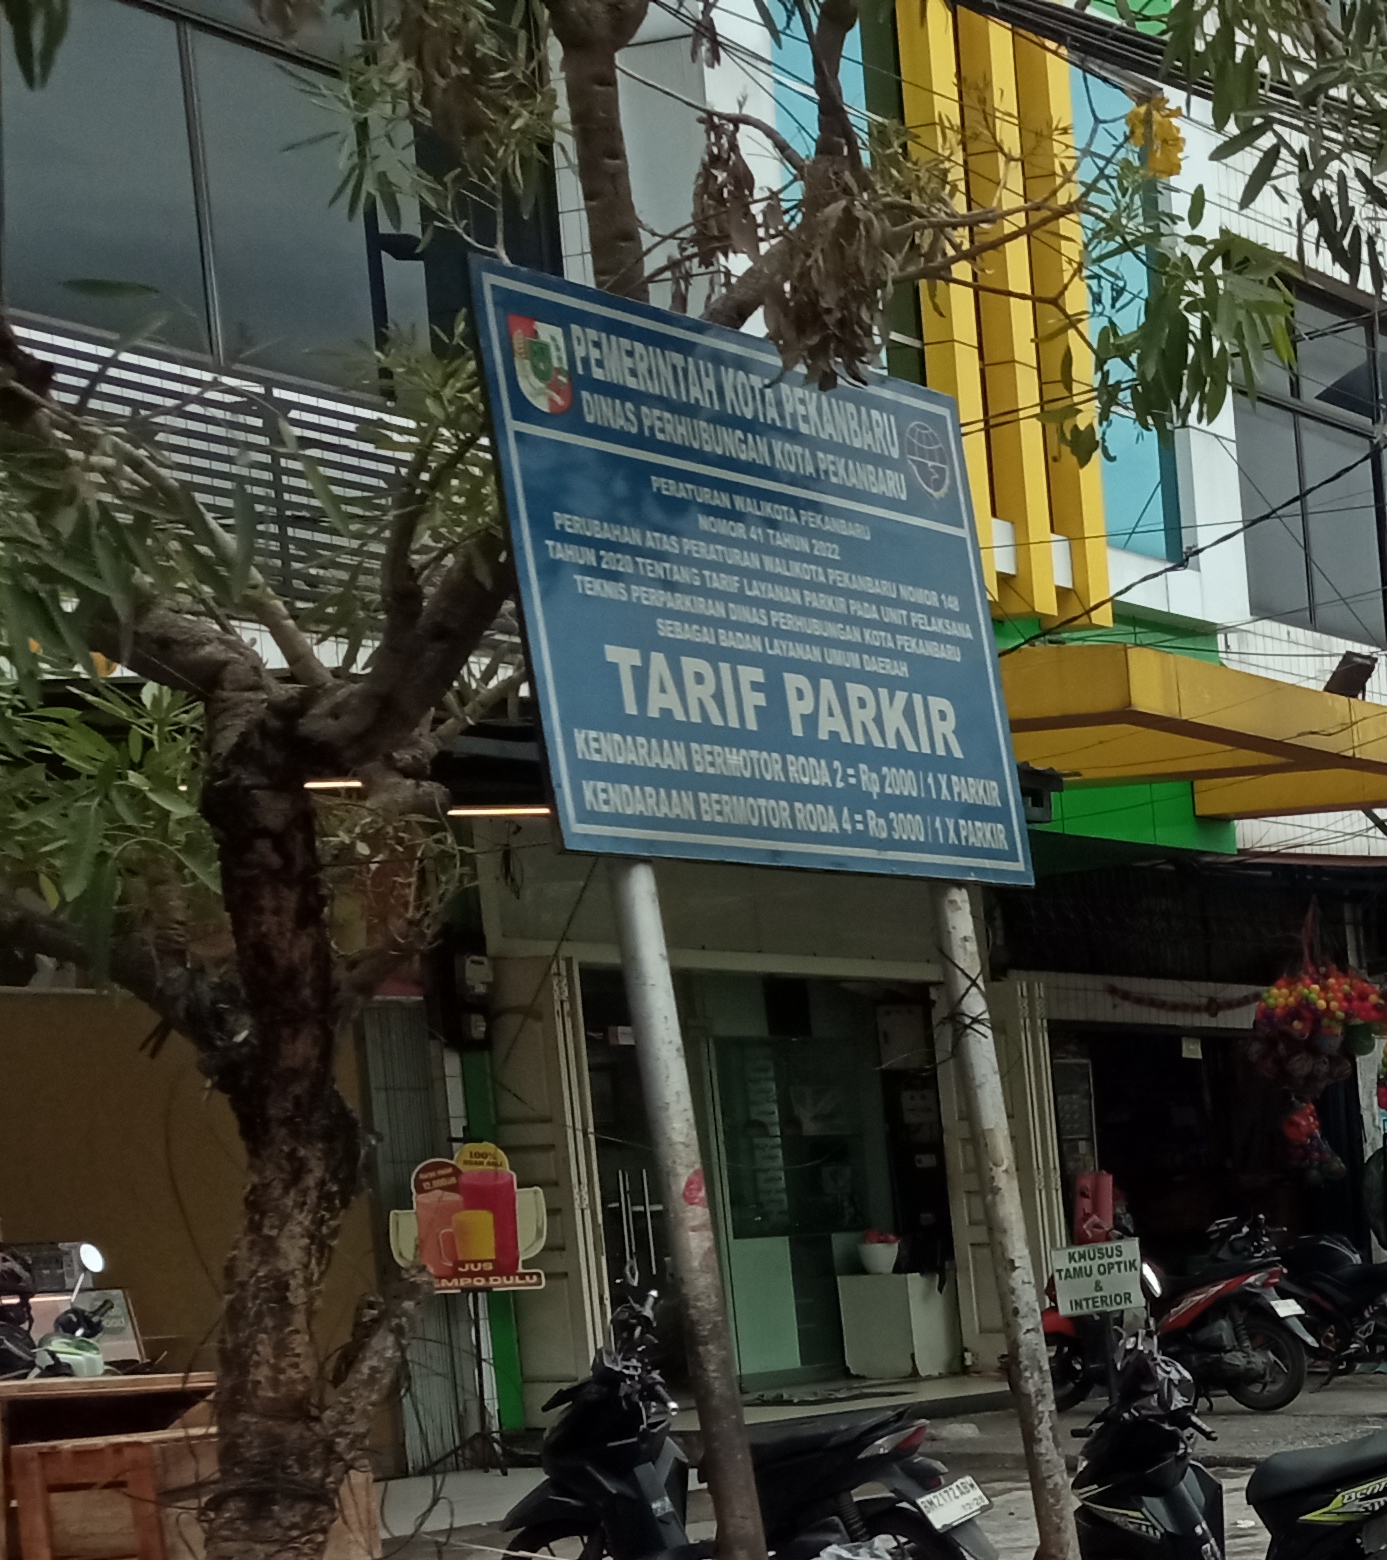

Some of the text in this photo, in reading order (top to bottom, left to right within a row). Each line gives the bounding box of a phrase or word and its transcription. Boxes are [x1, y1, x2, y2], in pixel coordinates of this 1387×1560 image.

[570, 323, 899, 459] PEMERINTAH KOTA PEKANBARU
[581, 391, 907, 500] DINAS PERHUBUNGAN KOTA PEKANBARU
[651, 476, 870, 540] PERATURAN WALIKOTA PEKANBARU
[698, 514, 841, 560] NOMOR 41 TAHUN 2022
[545, 540, 973, 640] TAHUN 2020 TENTANG TARIF LAYANAN PARKIR PADA UNIT PELAKSANA
[553, 511, 643, 546] PERUBAHAN
[645, 530, 679, 553] ATAS
[682, 538, 760, 570] PERATURAN
[762, 554, 826, 583] WALIKOTA
[827, 569, 897, 598] PEKANBARU
[899, 584, 940, 607] NOMOR
[573, 575, 961, 662] TEKNIS PERPARKIRAN DINAS PERHUBUNGAN KOTA PEKANBARU
[656, 618, 909, 677] SEBAGAI BADAN LAYANAN UMUM DAERAH
[604, 644, 965, 759] TARIF PARKIR
[574, 728, 689, 771] KENDARAAN
[690, 743, 785, 782] BERMOTOR
[786, 754, 832, 787] RODA
[833, 760, 845, 788] 2
[847, 768, 857, 784] =
[859, 764, 880, 799] Rp
[882, 767, 918, 797] 2000
[927, 772, 937, 799] 1
[938, 774, 951, 800] X
[951, 775, 1002, 807] PARKIR
[582, 780, 697, 820] KENDARAAN
[698, 792, 793, 829] BERMOTOR
[794, 802, 839, 834] RODA
[842, 807, 852, 834] 4
[854, 814, 864, 830] =
[866, 810, 888, 840] Rp
[889, 812, 925, 842] 3000
[935, 816, 944, 843] 1
[945, 818, 958, 844] X
[959, 819, 1009, 850] PARKIR
[434, 1274, 538, 1287] EMPO DULU
[458, 1262, 494, 1272] JUS
[1056, 1259, 1138, 1281] TAMU OPTIK
[1068, 1245, 1123, 1264] KHUSUS
[1094, 1280, 1103, 1292] &
[1069, 1292, 1133, 1311] INTERIOR
